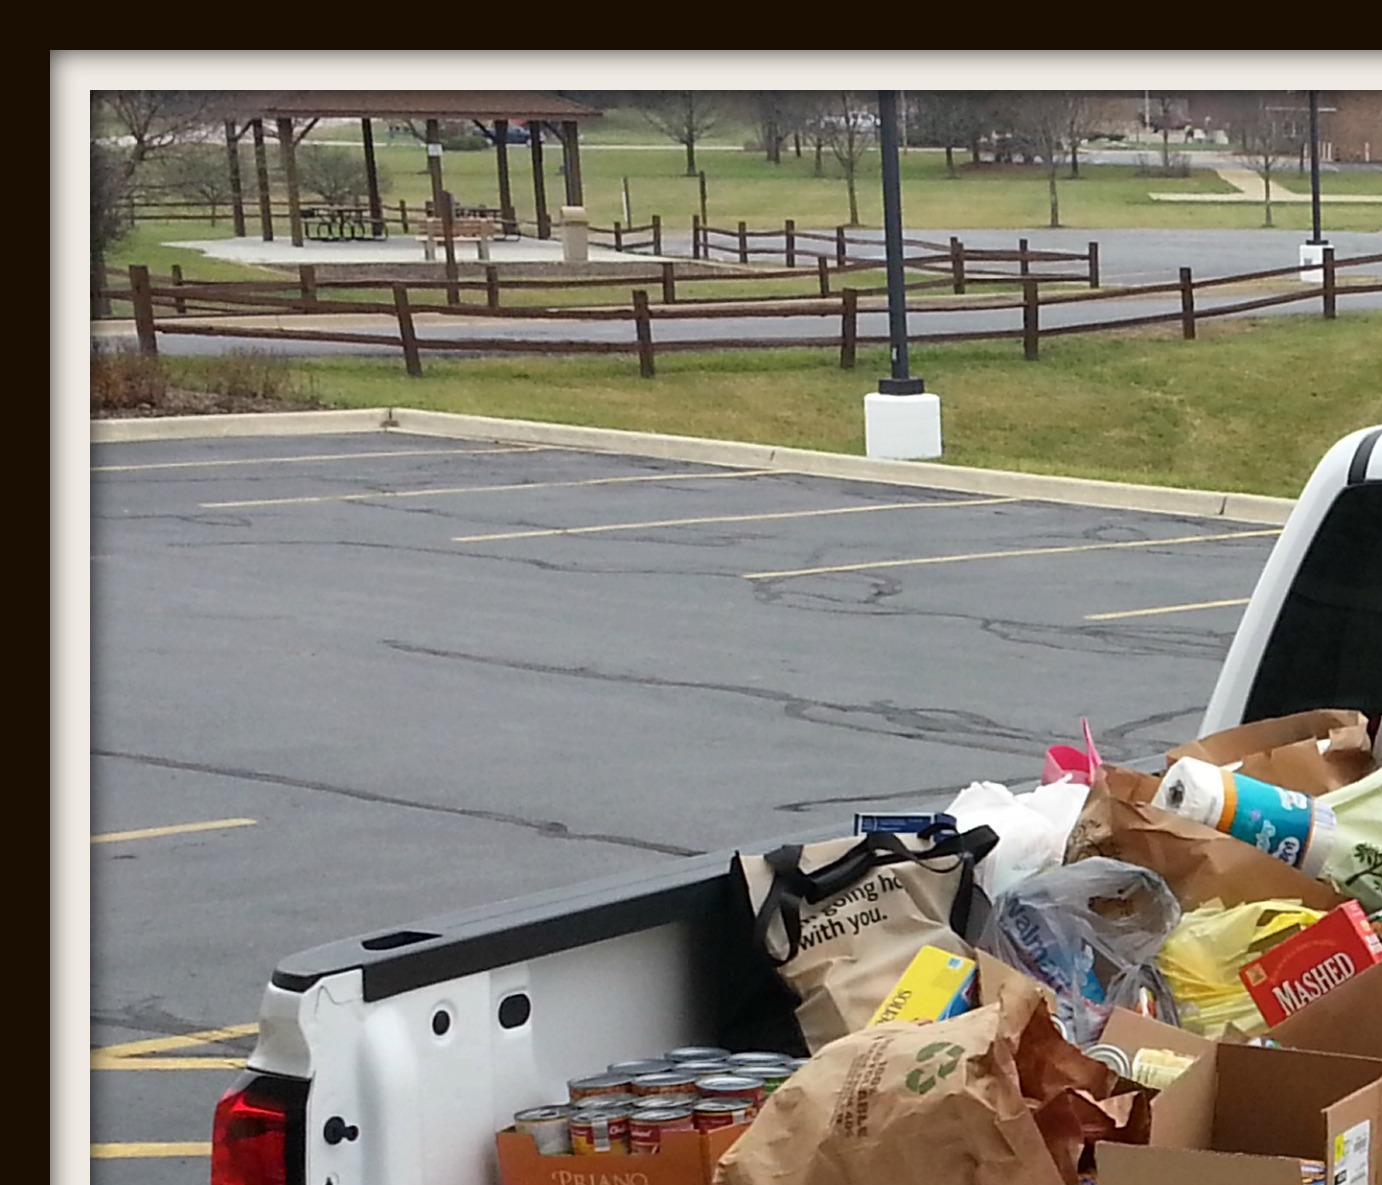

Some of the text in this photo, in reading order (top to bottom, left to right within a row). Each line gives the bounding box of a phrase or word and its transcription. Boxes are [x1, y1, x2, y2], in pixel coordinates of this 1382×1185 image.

[799, 918, 846, 951] with
[847, 906, 888, 936] you.
[1272, 952, 1356, 1016] MASHED
